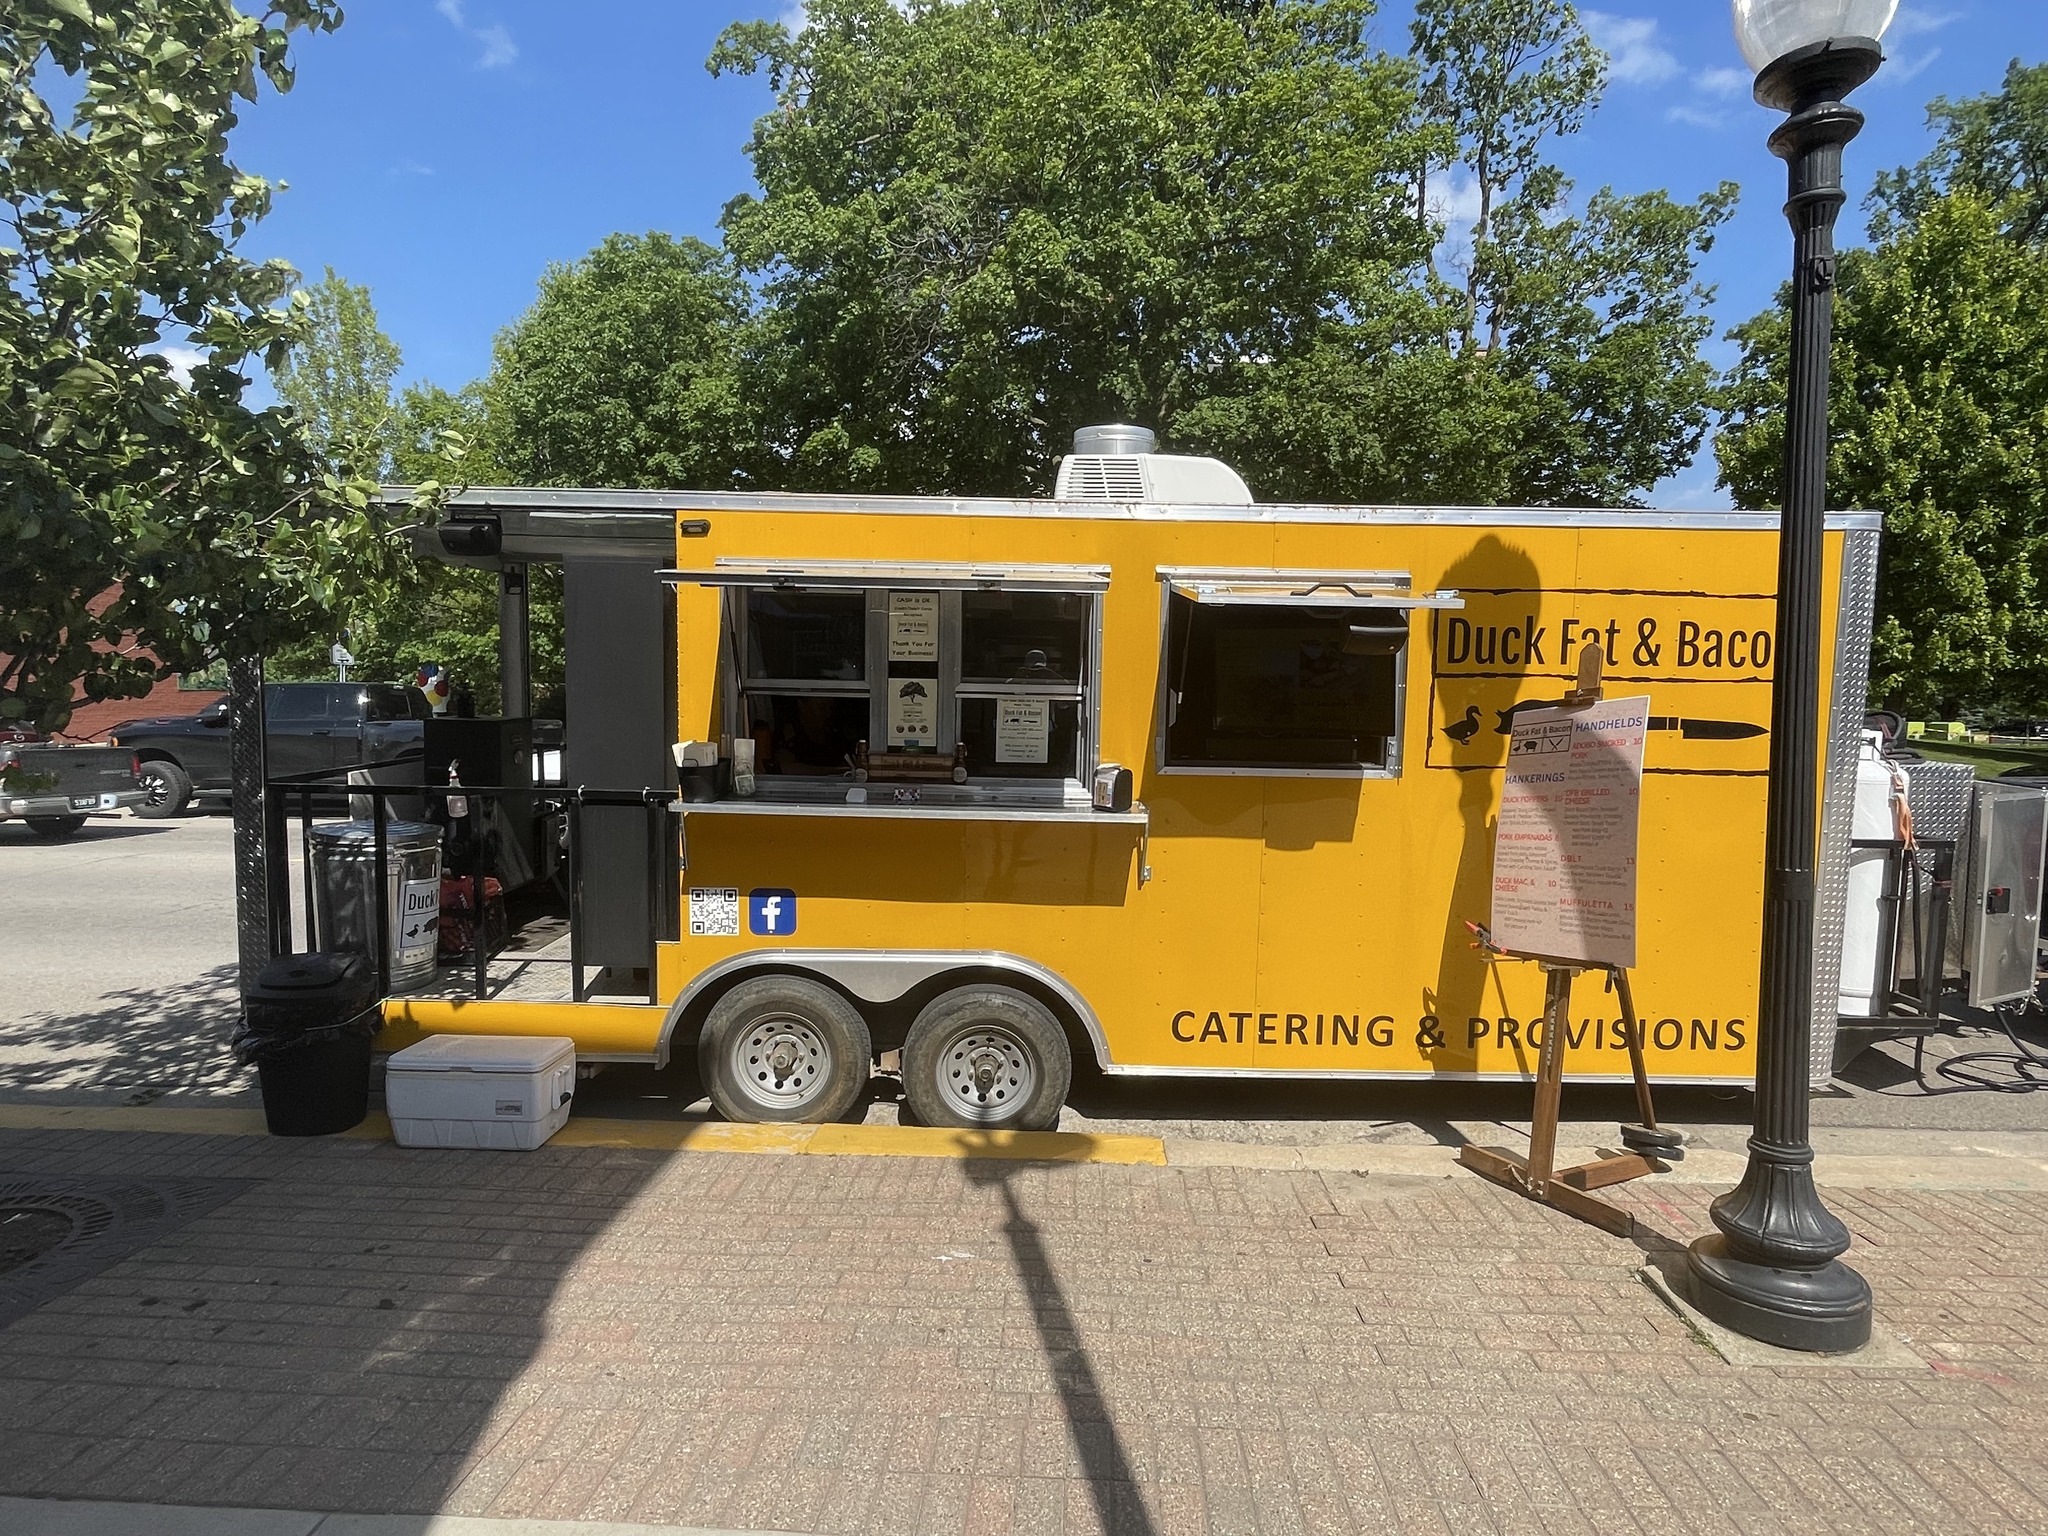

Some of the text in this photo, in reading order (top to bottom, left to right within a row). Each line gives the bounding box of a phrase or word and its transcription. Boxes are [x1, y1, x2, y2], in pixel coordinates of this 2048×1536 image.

[1447, 615, 1546, 665] Duck
[1632, 617, 1661, 667] &
[1677, 620, 1772, 668] Baco
[1575, 717, 1643, 732] HANDHELDS
[1513, 725, 1572, 738] Duck Fat & Bacon
[1572, 737, 1643, 750] ADOBO SMOKED 10
[1505, 772, 1565, 784] HANKERINGS
[1581, 788, 1610, 796] GRILLED
[1628, 787, 1638, 795] 10
[1503, 796, 1520, 804] DUCK
[1520, 795, 1549, 803] POPPERS
[1564, 797, 1591, 805] CHEESE
[1514, 833, 1553, 841] EMPANADAS
[1560, 855, 1636, 865] DBLT 13
[1495, 876, 1513, 884] DUCK
[1513, 877, 1528, 886] MAC
[1548, 880, 1557, 888] 10
[1494, 884, 1518, 893] CHEESE
[408, 889, 435, 911] Duck
[1560, 898, 1614, 910] MUFFULETTA
[1623, 903, 1634, 912] 15
[1171, 1010, 1746, 1052] CATERING & PROVISIONS
